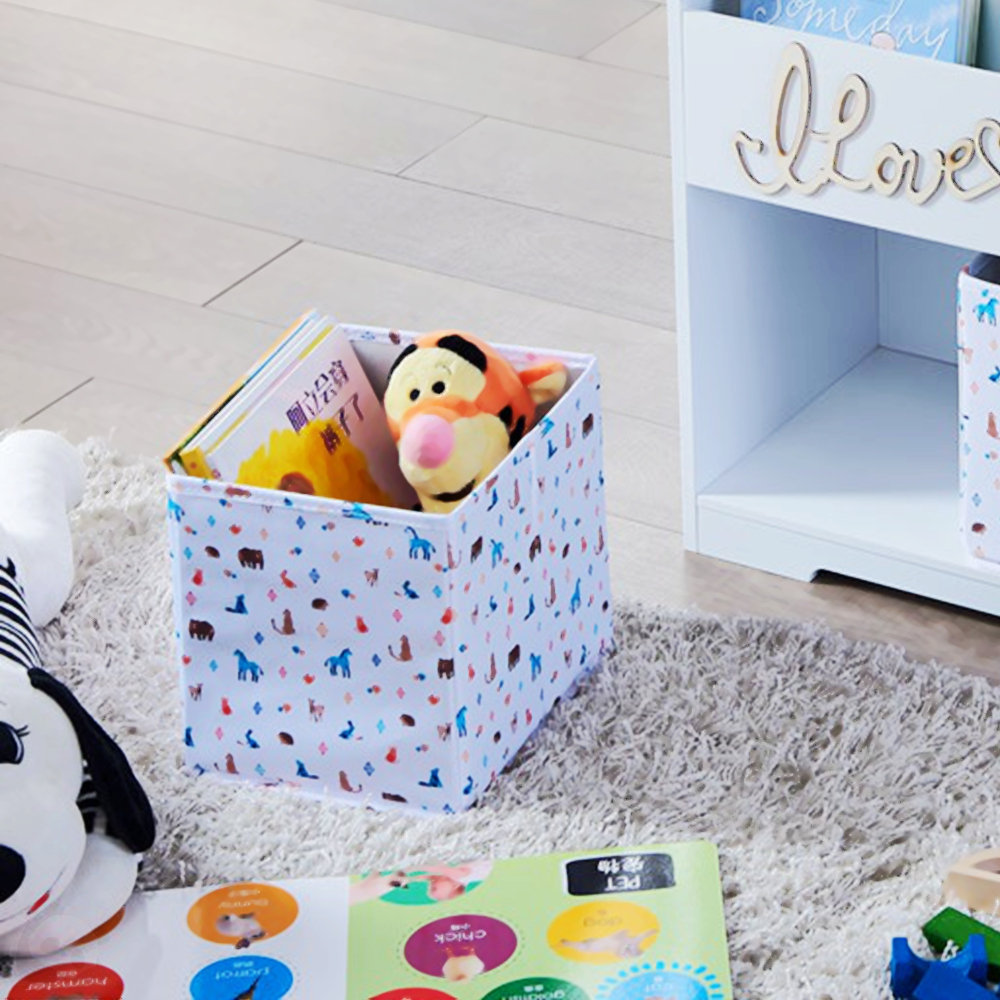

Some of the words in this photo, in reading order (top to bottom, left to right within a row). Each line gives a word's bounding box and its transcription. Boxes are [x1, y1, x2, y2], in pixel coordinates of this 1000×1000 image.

[604, 875, 641, 891] PET
[434, 929, 487, 944] chick
[215, 966, 270, 980] parrot
[26, 976, 108, 991] hamster
